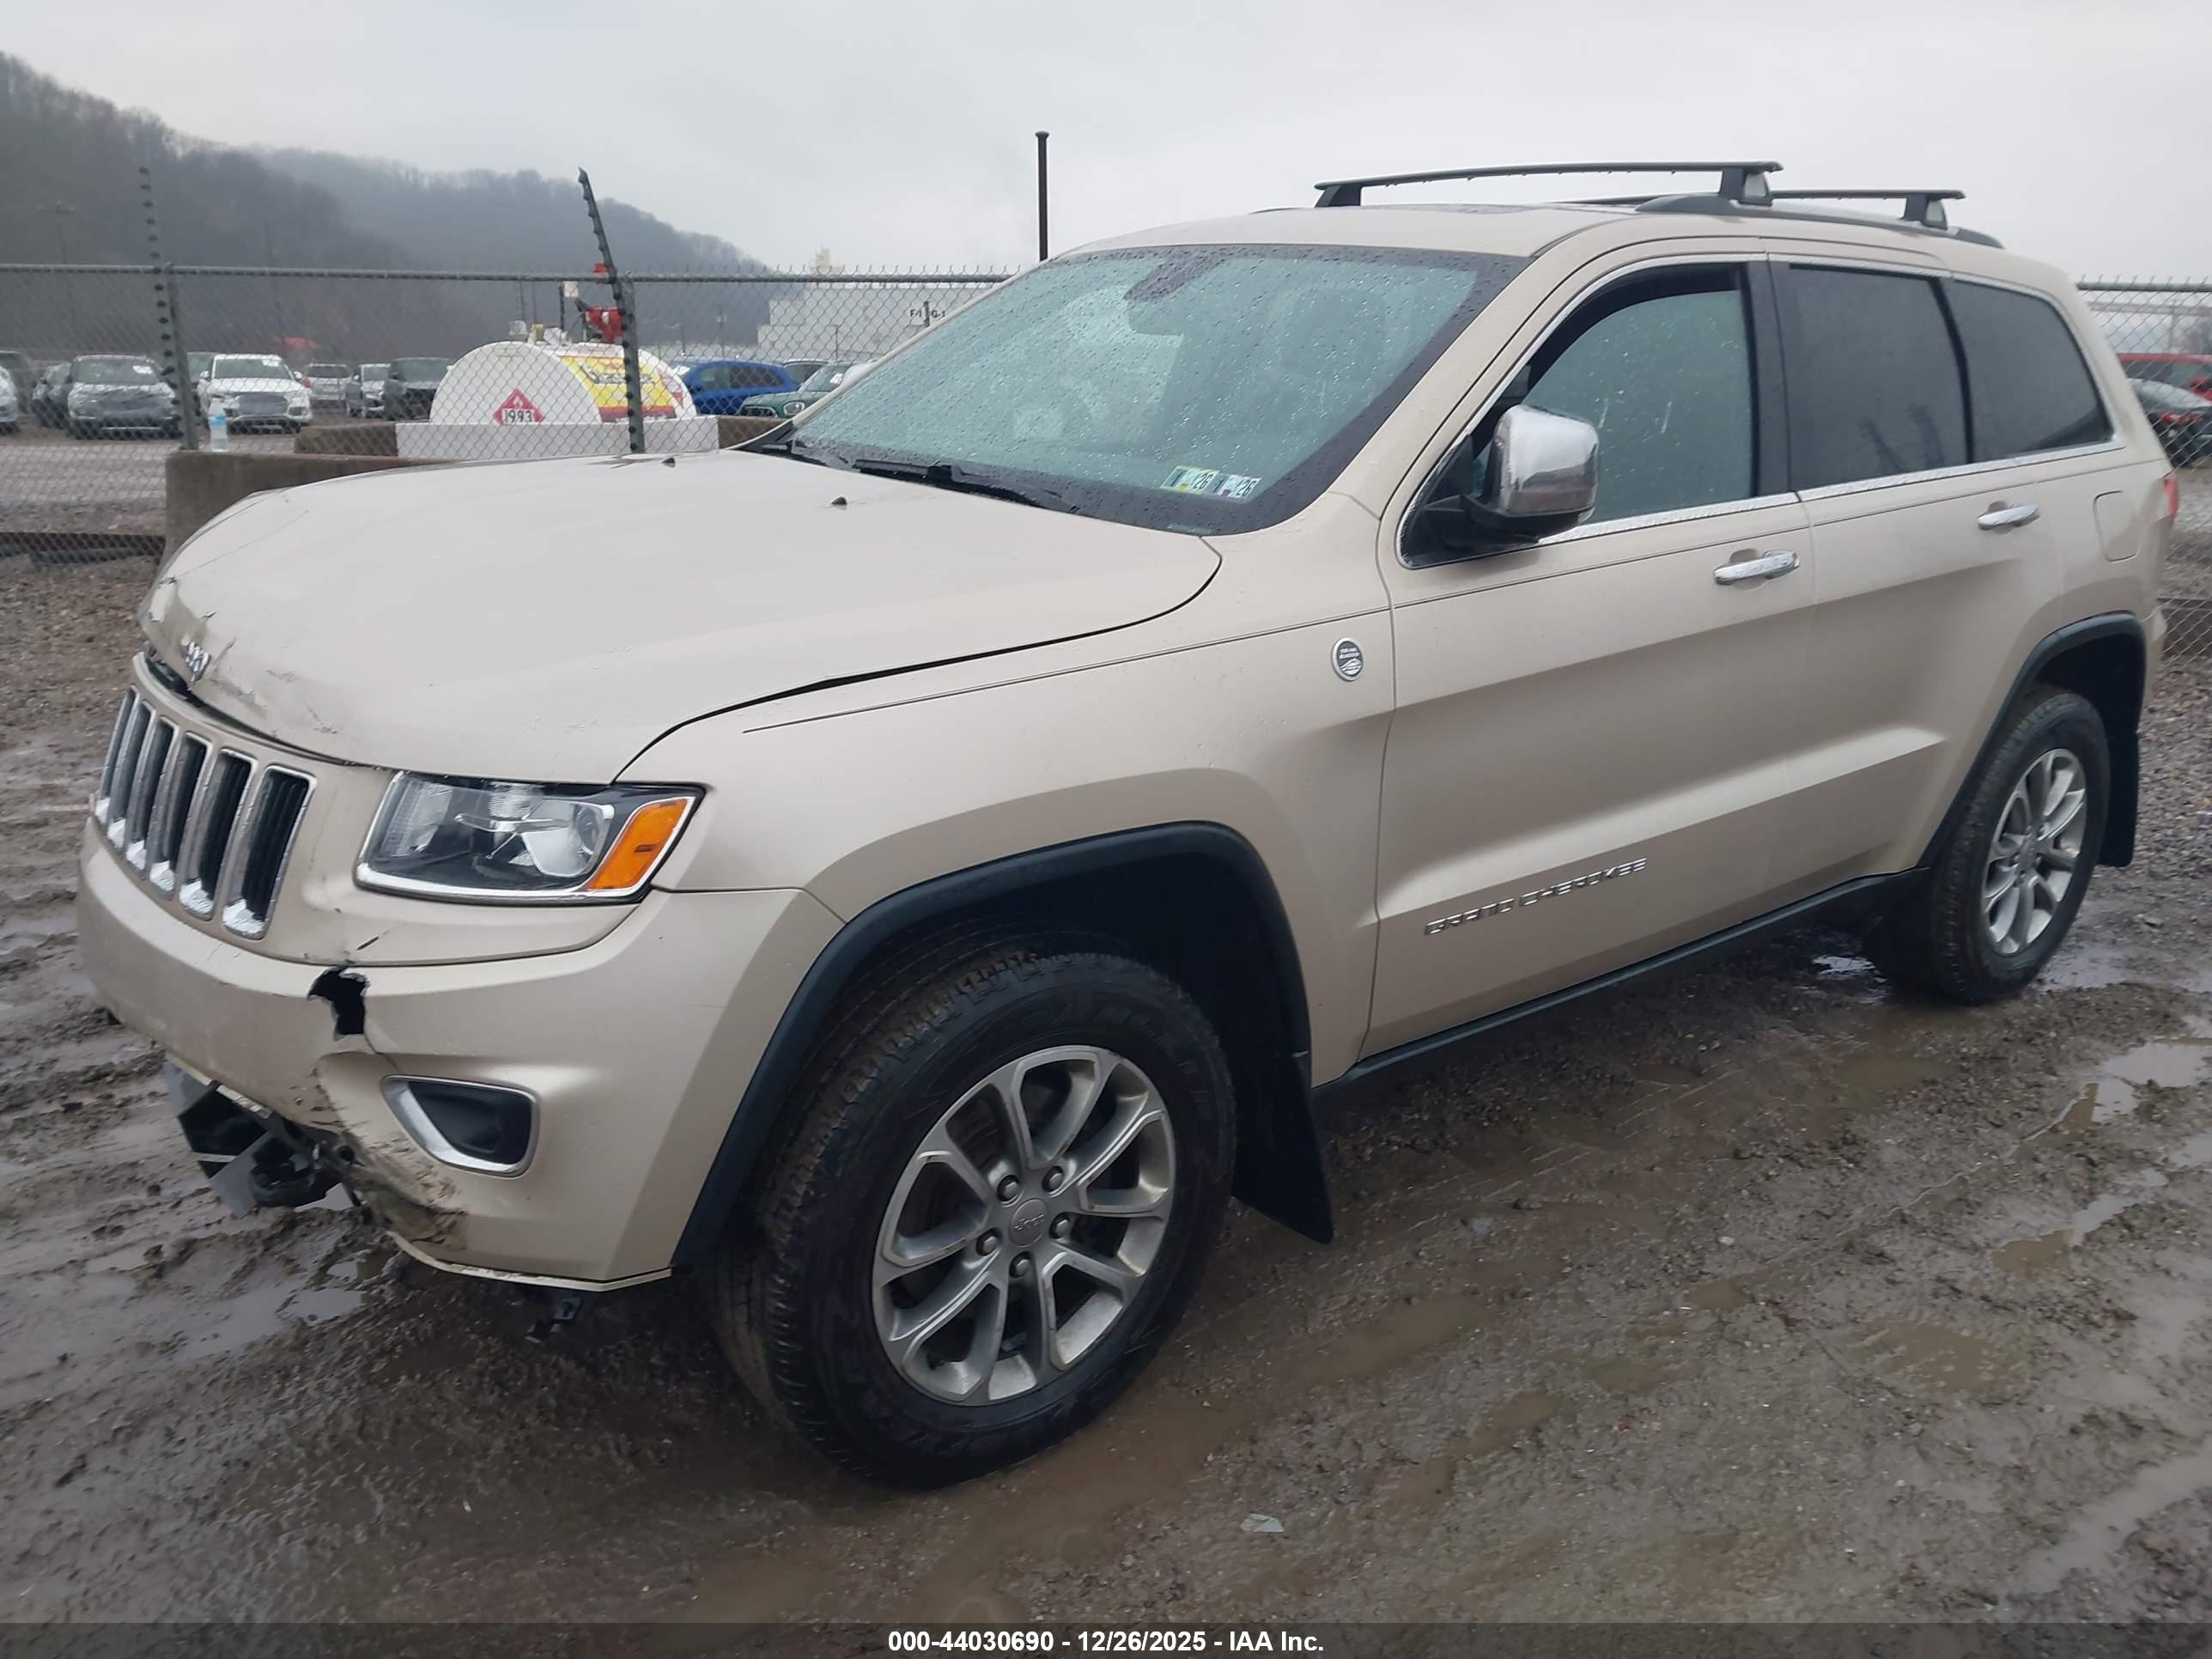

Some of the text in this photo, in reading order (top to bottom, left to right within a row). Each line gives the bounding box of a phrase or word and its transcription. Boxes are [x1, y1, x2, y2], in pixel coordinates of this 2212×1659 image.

[504, 410, 532, 422] 1993
[1424, 857, 1648, 935] GRAND CHEROKEE
